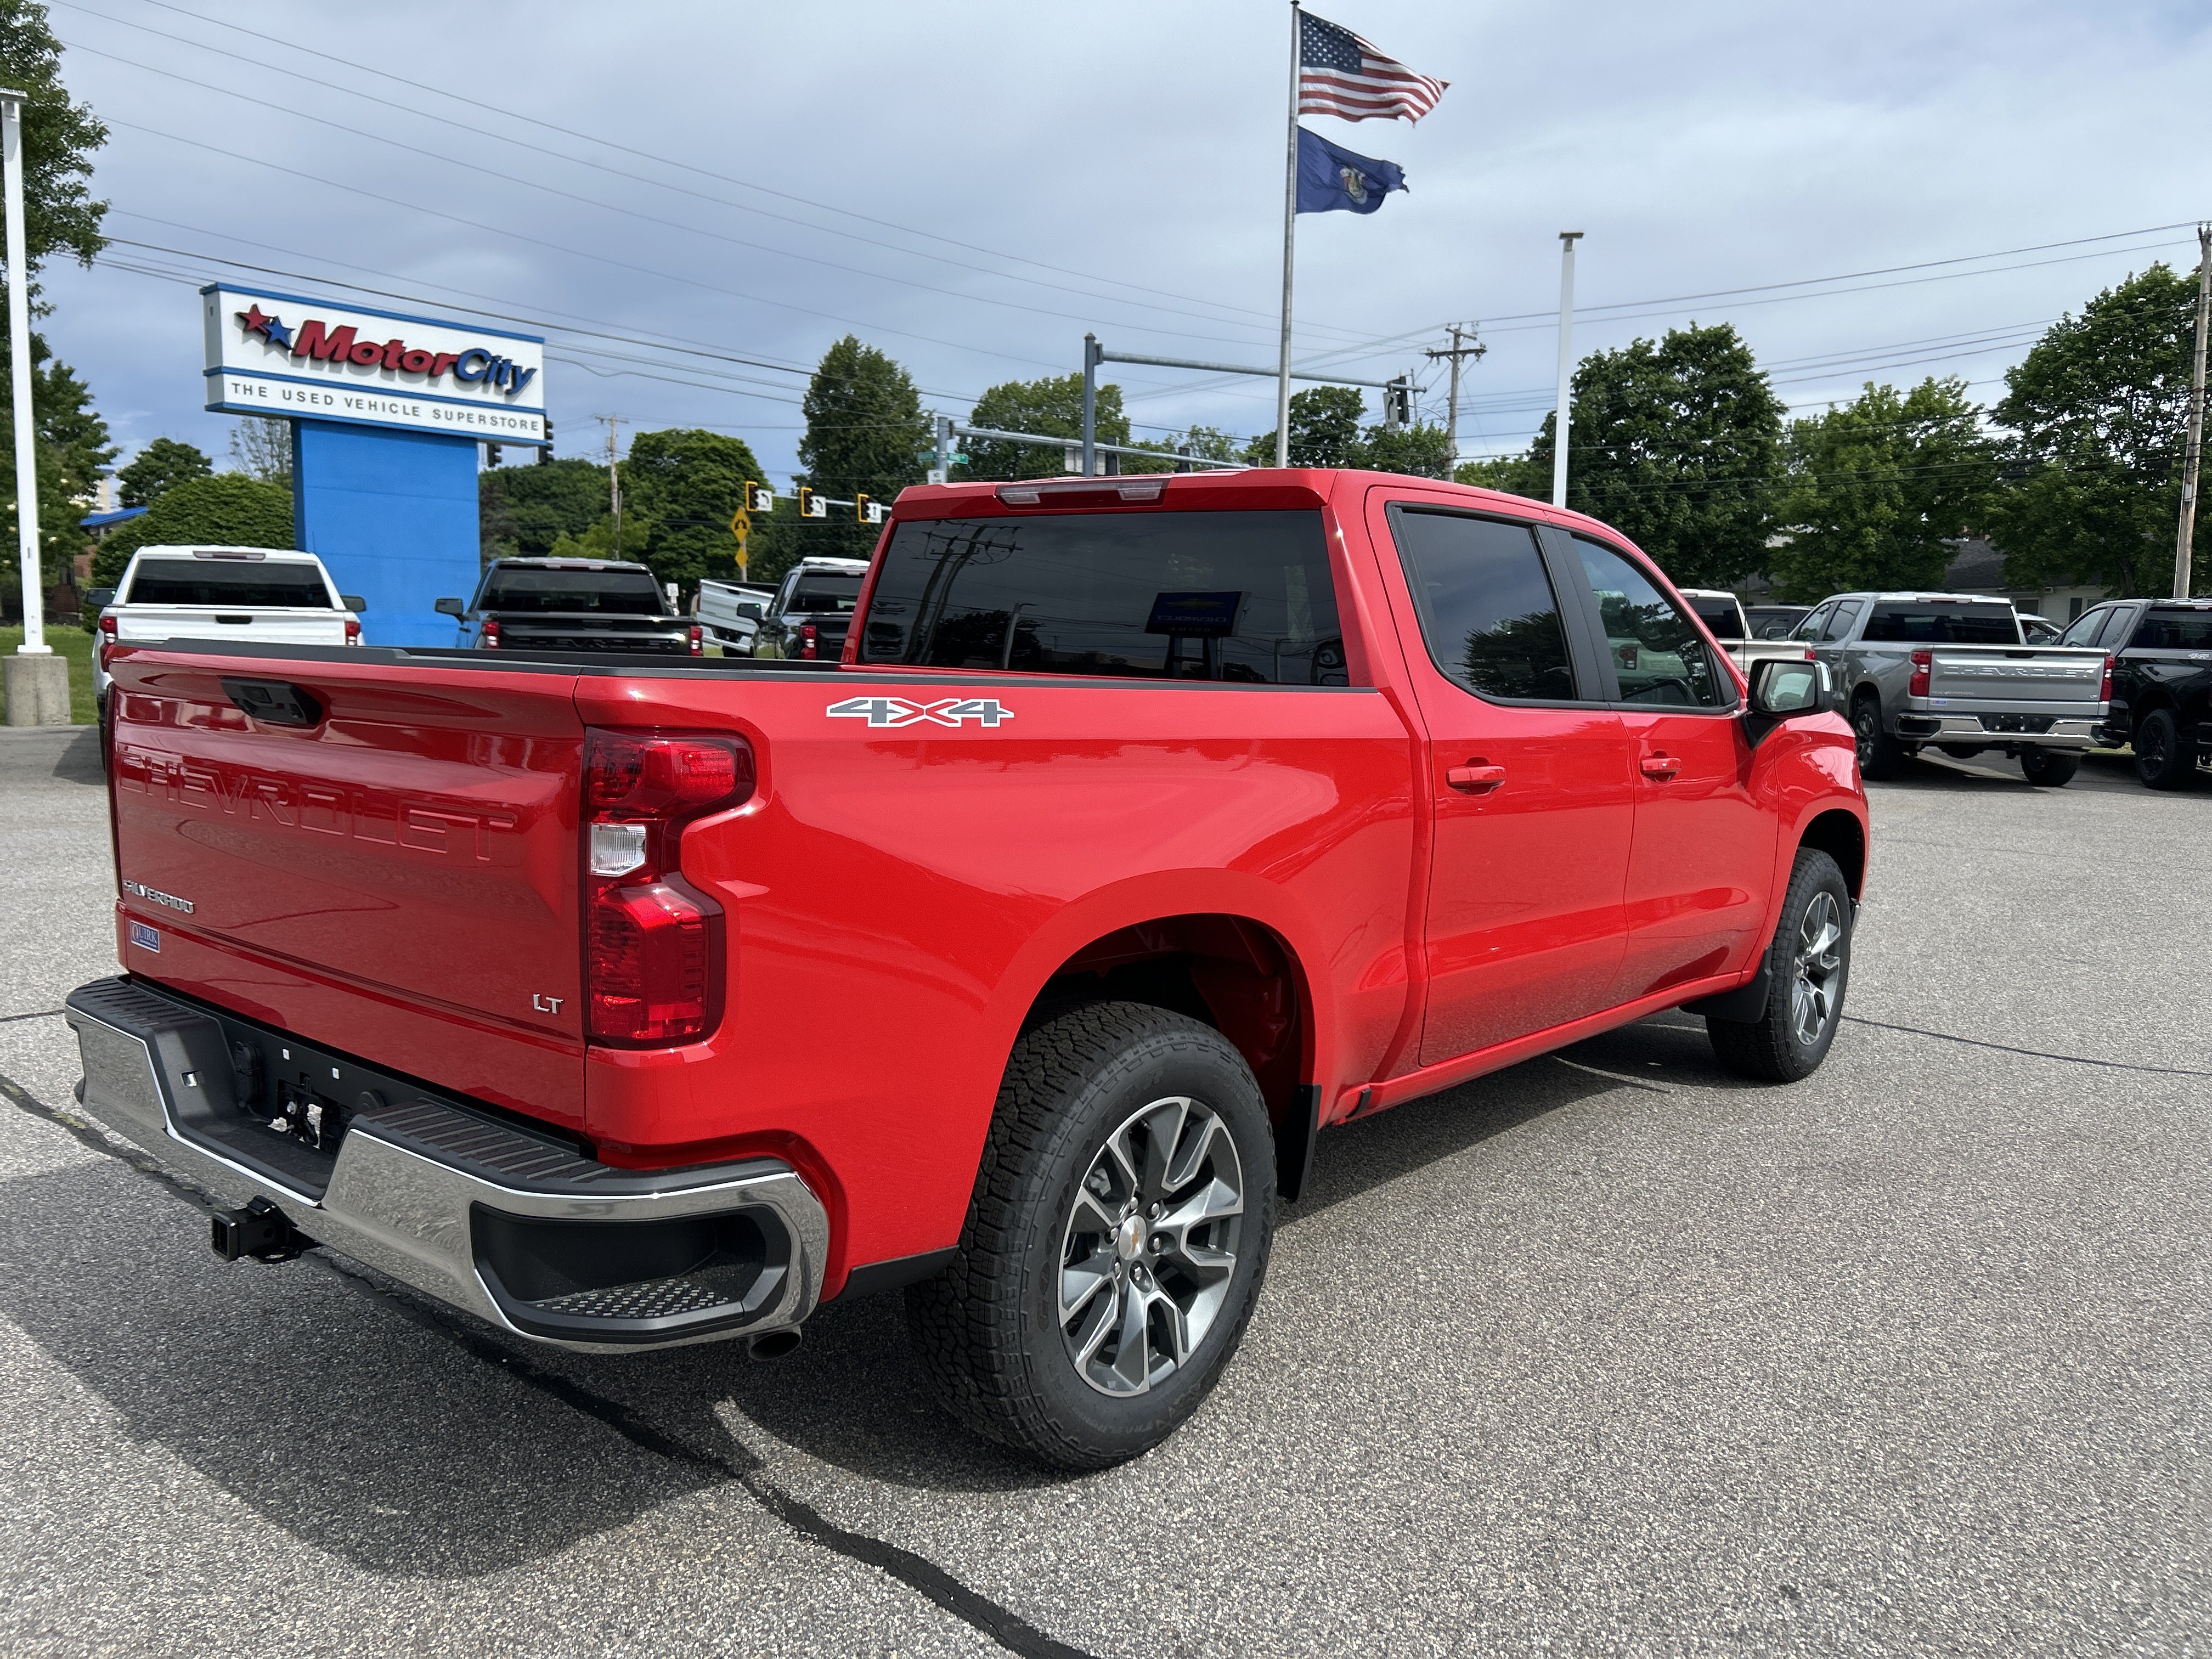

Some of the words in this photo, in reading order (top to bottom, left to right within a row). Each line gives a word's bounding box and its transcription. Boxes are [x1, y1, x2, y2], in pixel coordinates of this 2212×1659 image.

[290, 319, 537, 395] MotorCity
[232, 383, 268, 398] THE
[282, 389, 334, 405] USED
[344, 397, 420, 417] VEHICLE
[432, 408, 539, 431] SUPERSTORE
[1943, 665, 2095, 678] CHEVROLET
[119, 749, 517, 861] CHEVROLET
[123, 879, 194, 915] SILVERADO
[132, 924, 157, 944] QUIRK
[533, 994, 564, 1014] LT
